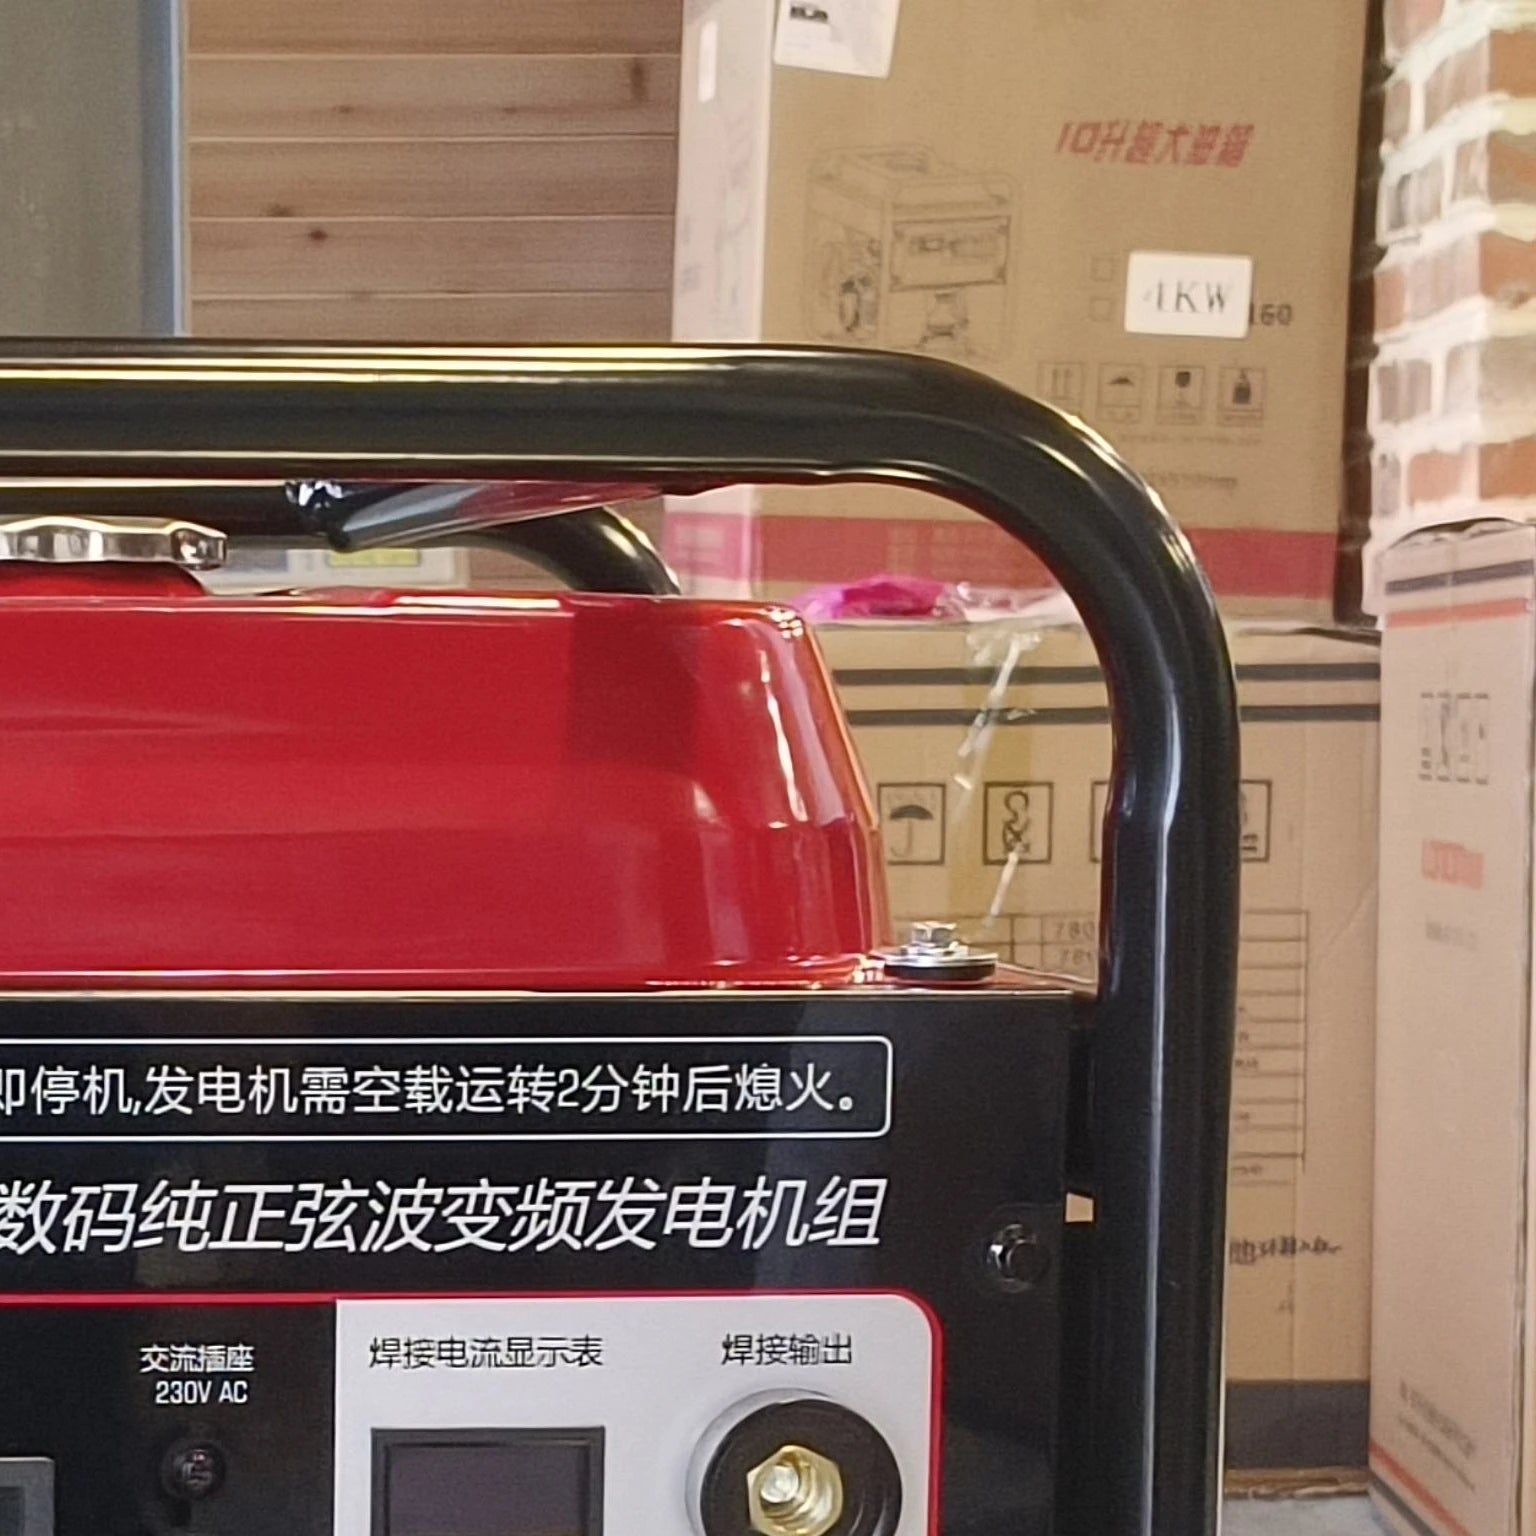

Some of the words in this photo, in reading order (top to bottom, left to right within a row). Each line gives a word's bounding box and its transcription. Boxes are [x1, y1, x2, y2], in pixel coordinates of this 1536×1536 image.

[139, 1343, 255, 1374] 交流插座
[369, 1335, 604, 1369] 焊接电流显示表
[722, 1333, 853, 1367] 焊接输出
[155, 1380, 212, 1404] 230V
[219, 1380, 248, 1404] AC
